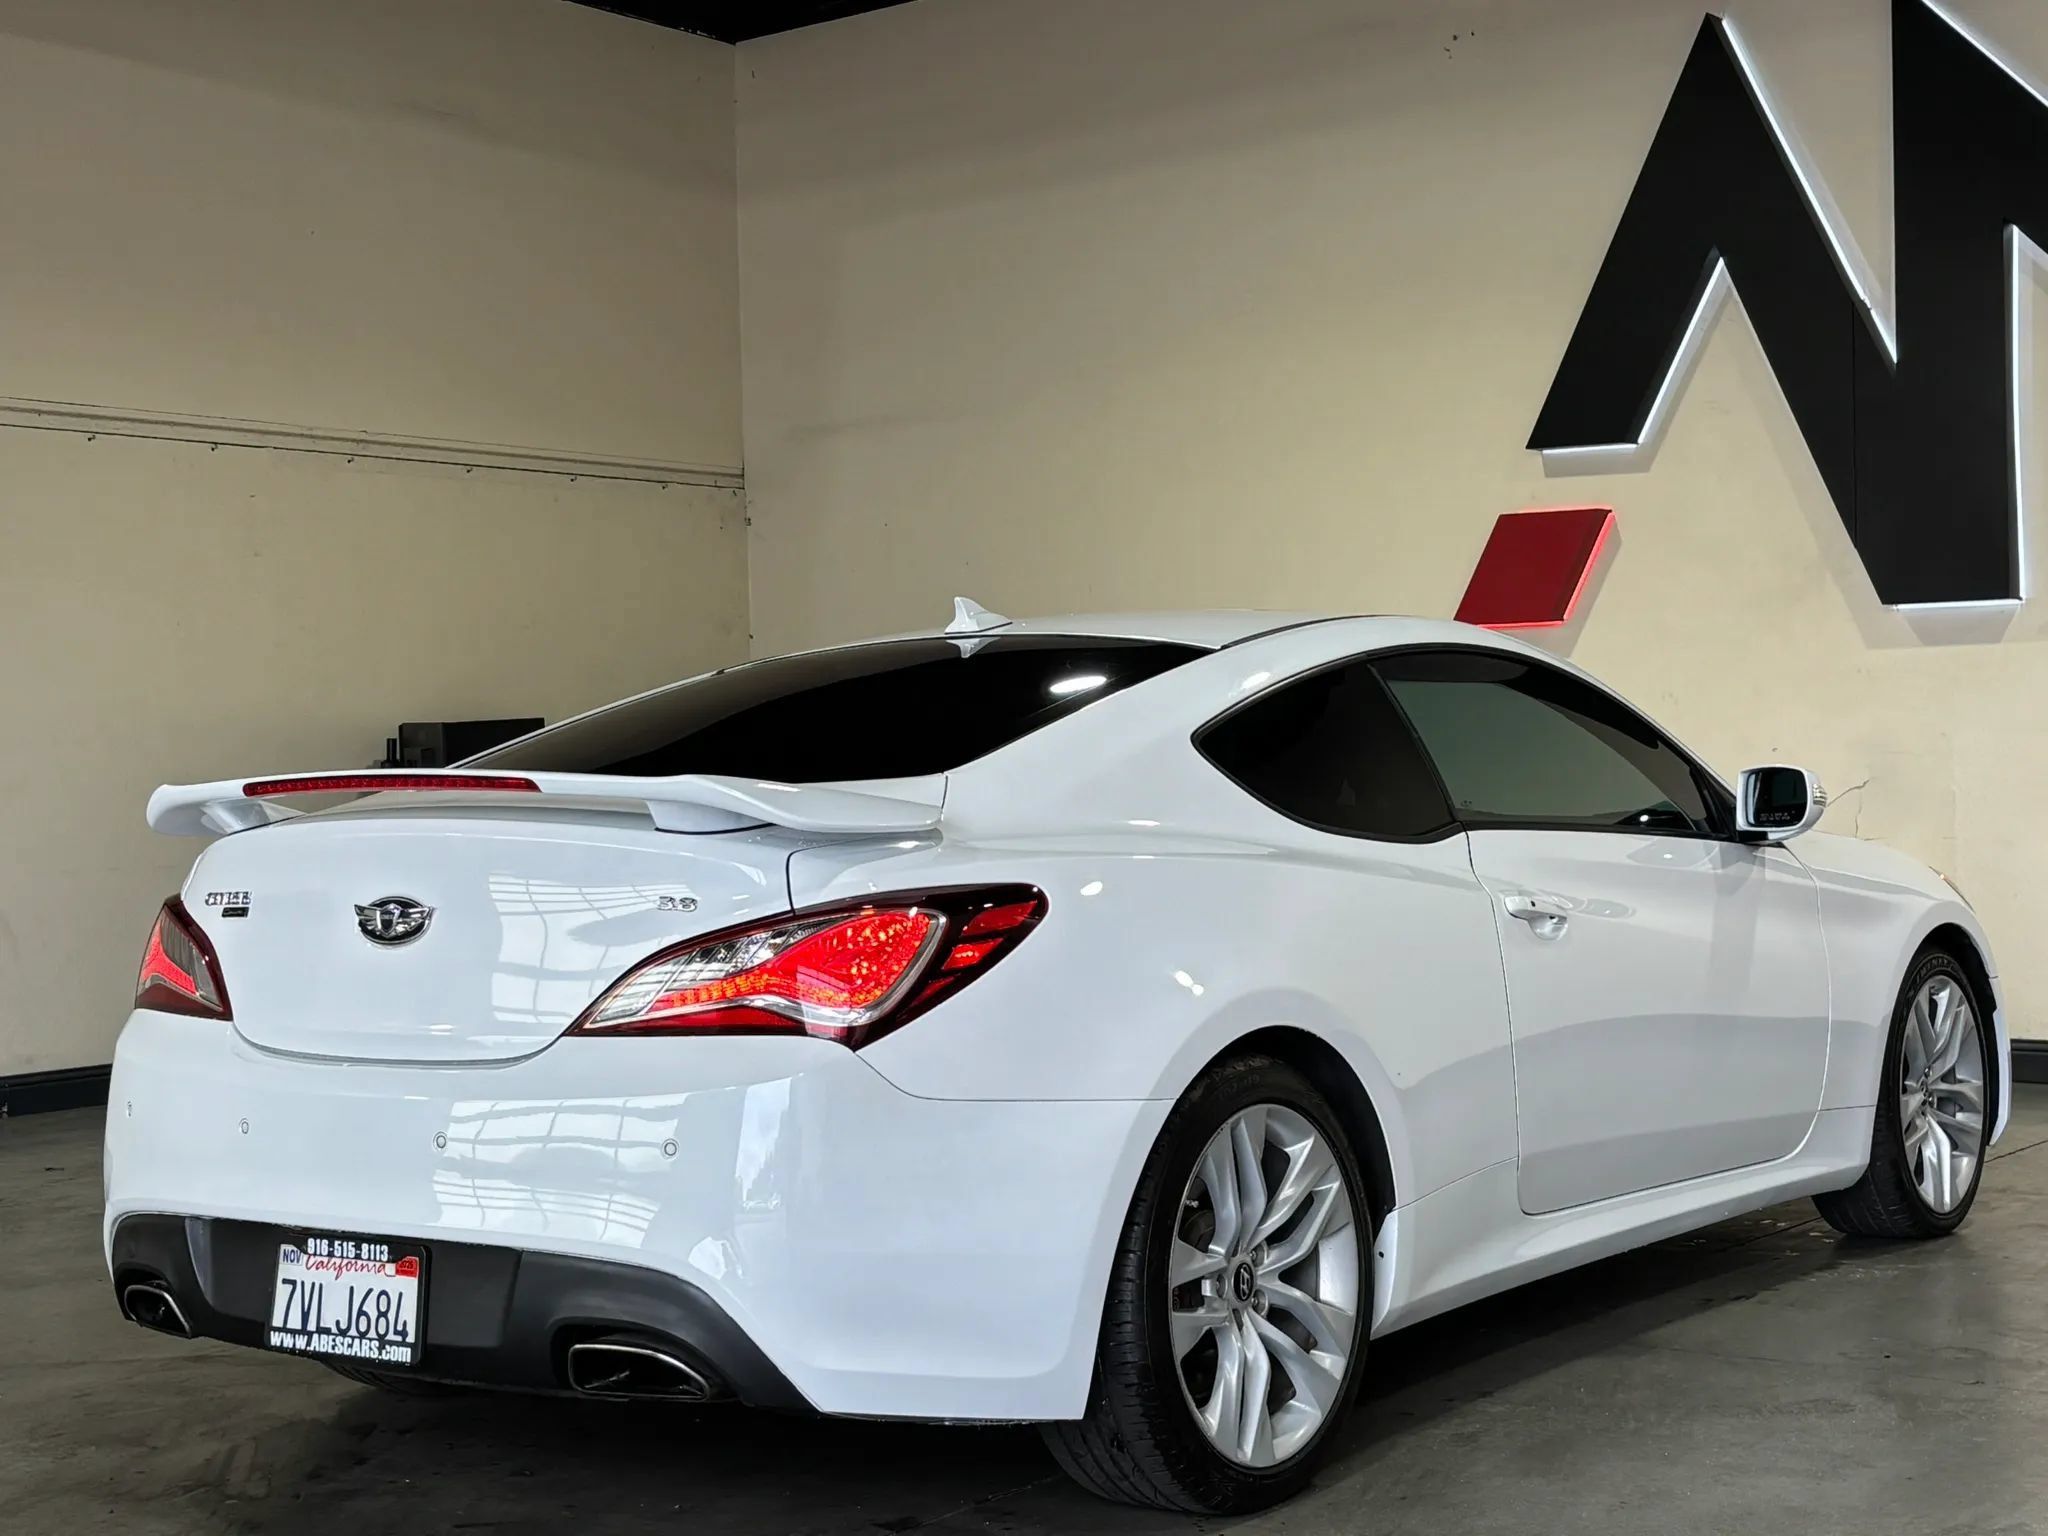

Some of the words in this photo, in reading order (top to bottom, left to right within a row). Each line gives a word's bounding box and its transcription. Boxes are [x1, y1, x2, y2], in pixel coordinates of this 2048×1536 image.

[282, 1249, 300, 1263] NOV
[307, 1238, 389, 1261] 916-515-8113
[305, 1254, 396, 1281] California
[281, 1278, 408, 1341] 7VLJ684
